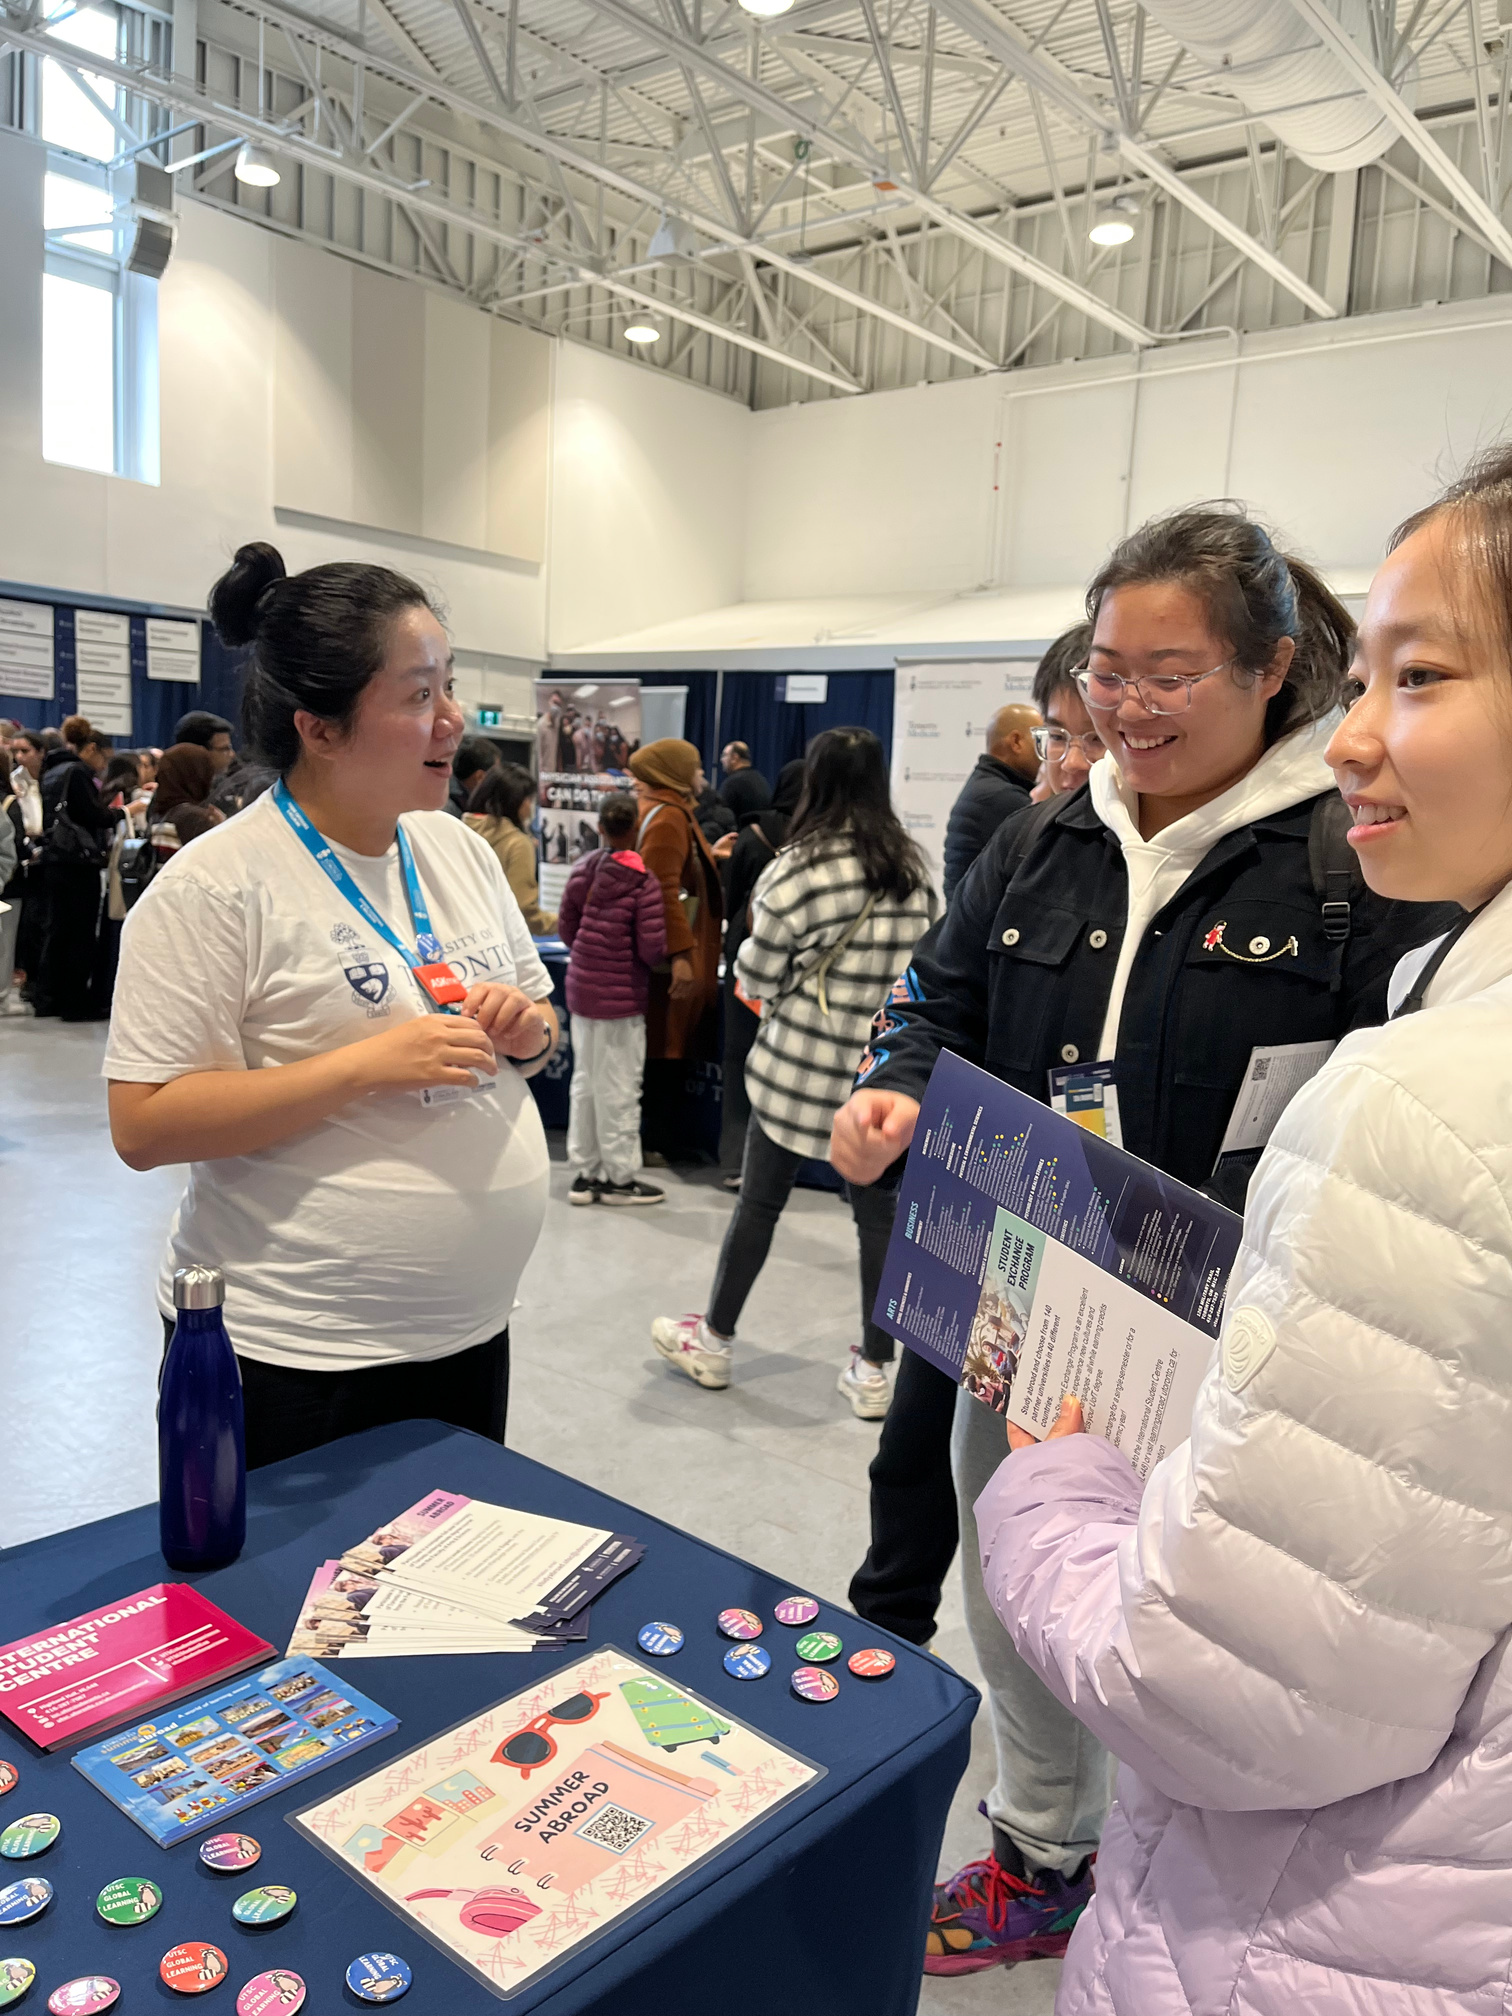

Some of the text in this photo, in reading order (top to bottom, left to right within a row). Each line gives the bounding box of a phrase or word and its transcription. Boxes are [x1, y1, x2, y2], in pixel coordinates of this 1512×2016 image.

[546, 786, 572, 801] CAN
[574, 788, 590, 802] DO
[904, 1201, 918, 1239] BUSINESS
[998, 1229, 1015, 1272] STUDENT
[1007, 1235, 1023, 1286] EXCHANGE
[1018, 1242, 1034, 1290] PROGRAM
[886, 1298, 897, 1319] ARTS
[1078, 1287, 1088, 1316] excellent
[1075, 1316, 1082, 1325] an
[1097, 1303, 1107, 1325] credits
[1067, 1331, 1078, 1358] Program
[1092, 1324, 1103, 1349] earning
[1125, 1331, 1134, 1342] for
[1125, 1340, 1132, 1350] or
[1072, 1357, 1084, 1391] experience
[1082, 1319, 1092, 1344] cultures
[1087, 1305, 1095, 1320] and
[1088, 1348, 1096, 1366] while
[1020, 1304, 1052, 1415] Study abroad and choose from 140
[1031, 1314, 1060, 1422] partner universities in 40 different
[1118, 1348, 1129, 1379] semester
[1151, 1358, 1163, 1381] Centre
[1060, 1358, 1074, 1389] Exchange
[1077, 1377, 1090, 1409] anguages
[1088, 1389, 1097, 1407] UofT
[1114, 1378, 1124, 1398] single
[1144, 1380, 1157, 1406] Student
[1040, 1396, 1052, 1427] countries.
[1109, 1401, 1117, 1411] for
[1143, 1454, 1150, 1463] or
[1169, 1348, 1177, 1358] for
[1051, 1412, 1061, 1425] The
[1136, 1404, 1151, 1444] International
[1131, 1454, 1139, 1462] to
[1133, 1444, 1141, 1455] the
[417, 1498, 445, 1518] SUMMER
[429, 1500, 455, 1520] ABROAD
[0, 1595, 168, 1667] TERNATIONAL
[0, 1633, 100, 1682] TUDENT
[0, 1646, 100, 1692] CENTRE
[138, 1722, 179, 1744] abroad
[514, 1770, 590, 1833] SUMMER
[539, 1781, 609, 1844] ABROAD
[103, 1890, 132, 1902] GLOBAL
[106, 1883, 125, 1892] UTSC
[0, 1893, 19, 1907] OBAL
[0, 1894, 29, 1915] EARNING
[102, 1896, 140, 1912] LEARNING
[166, 1956, 195, 1968] GLOBAL
[168, 1948, 188, 1958] UTSC
[166, 1963, 204, 1979] LEARNING
[239, 1985, 257, 2002] UTSC
[243, 1988, 268, 2011] GLOBAL
